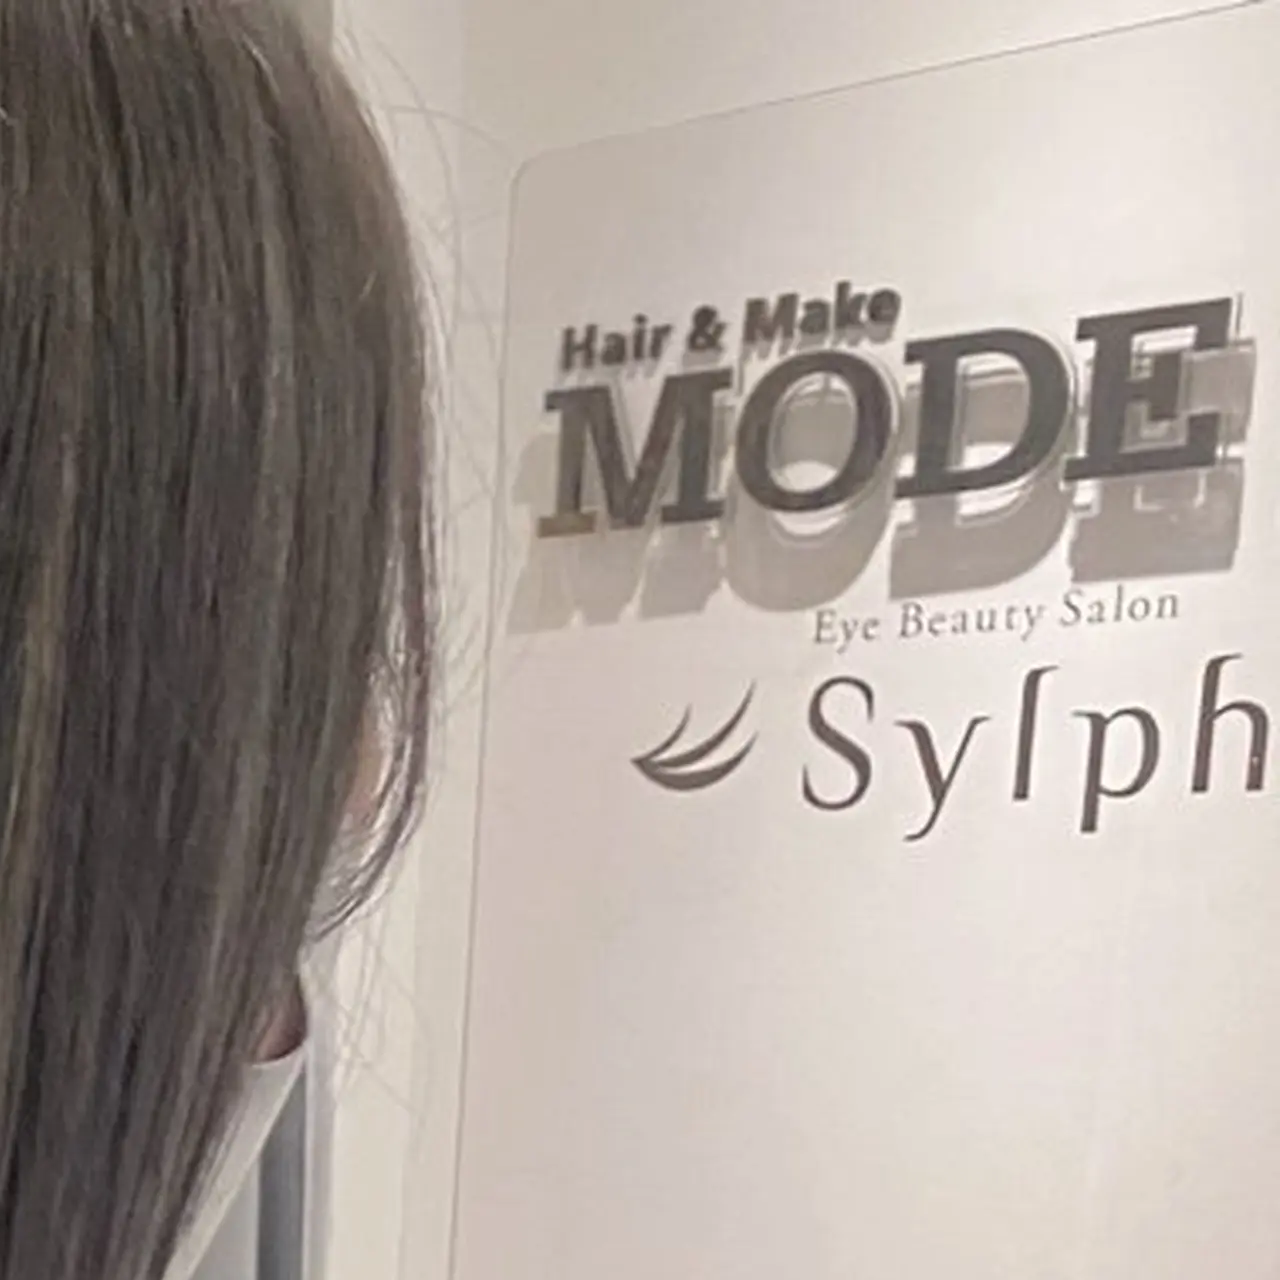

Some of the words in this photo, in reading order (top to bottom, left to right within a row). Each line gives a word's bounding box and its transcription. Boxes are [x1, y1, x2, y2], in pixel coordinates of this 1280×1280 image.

[561, 313, 673, 371] Hair
[687, 304, 728, 351] &
[743, 281, 902, 343] Make
[537, 297, 1233, 538] MODE
[813, 607, 881, 654] Eye
[899, 600, 1045, 642] Beauty
[1060, 585, 1180, 628] Salon
[801, 652, 1270, 842] Sylph
